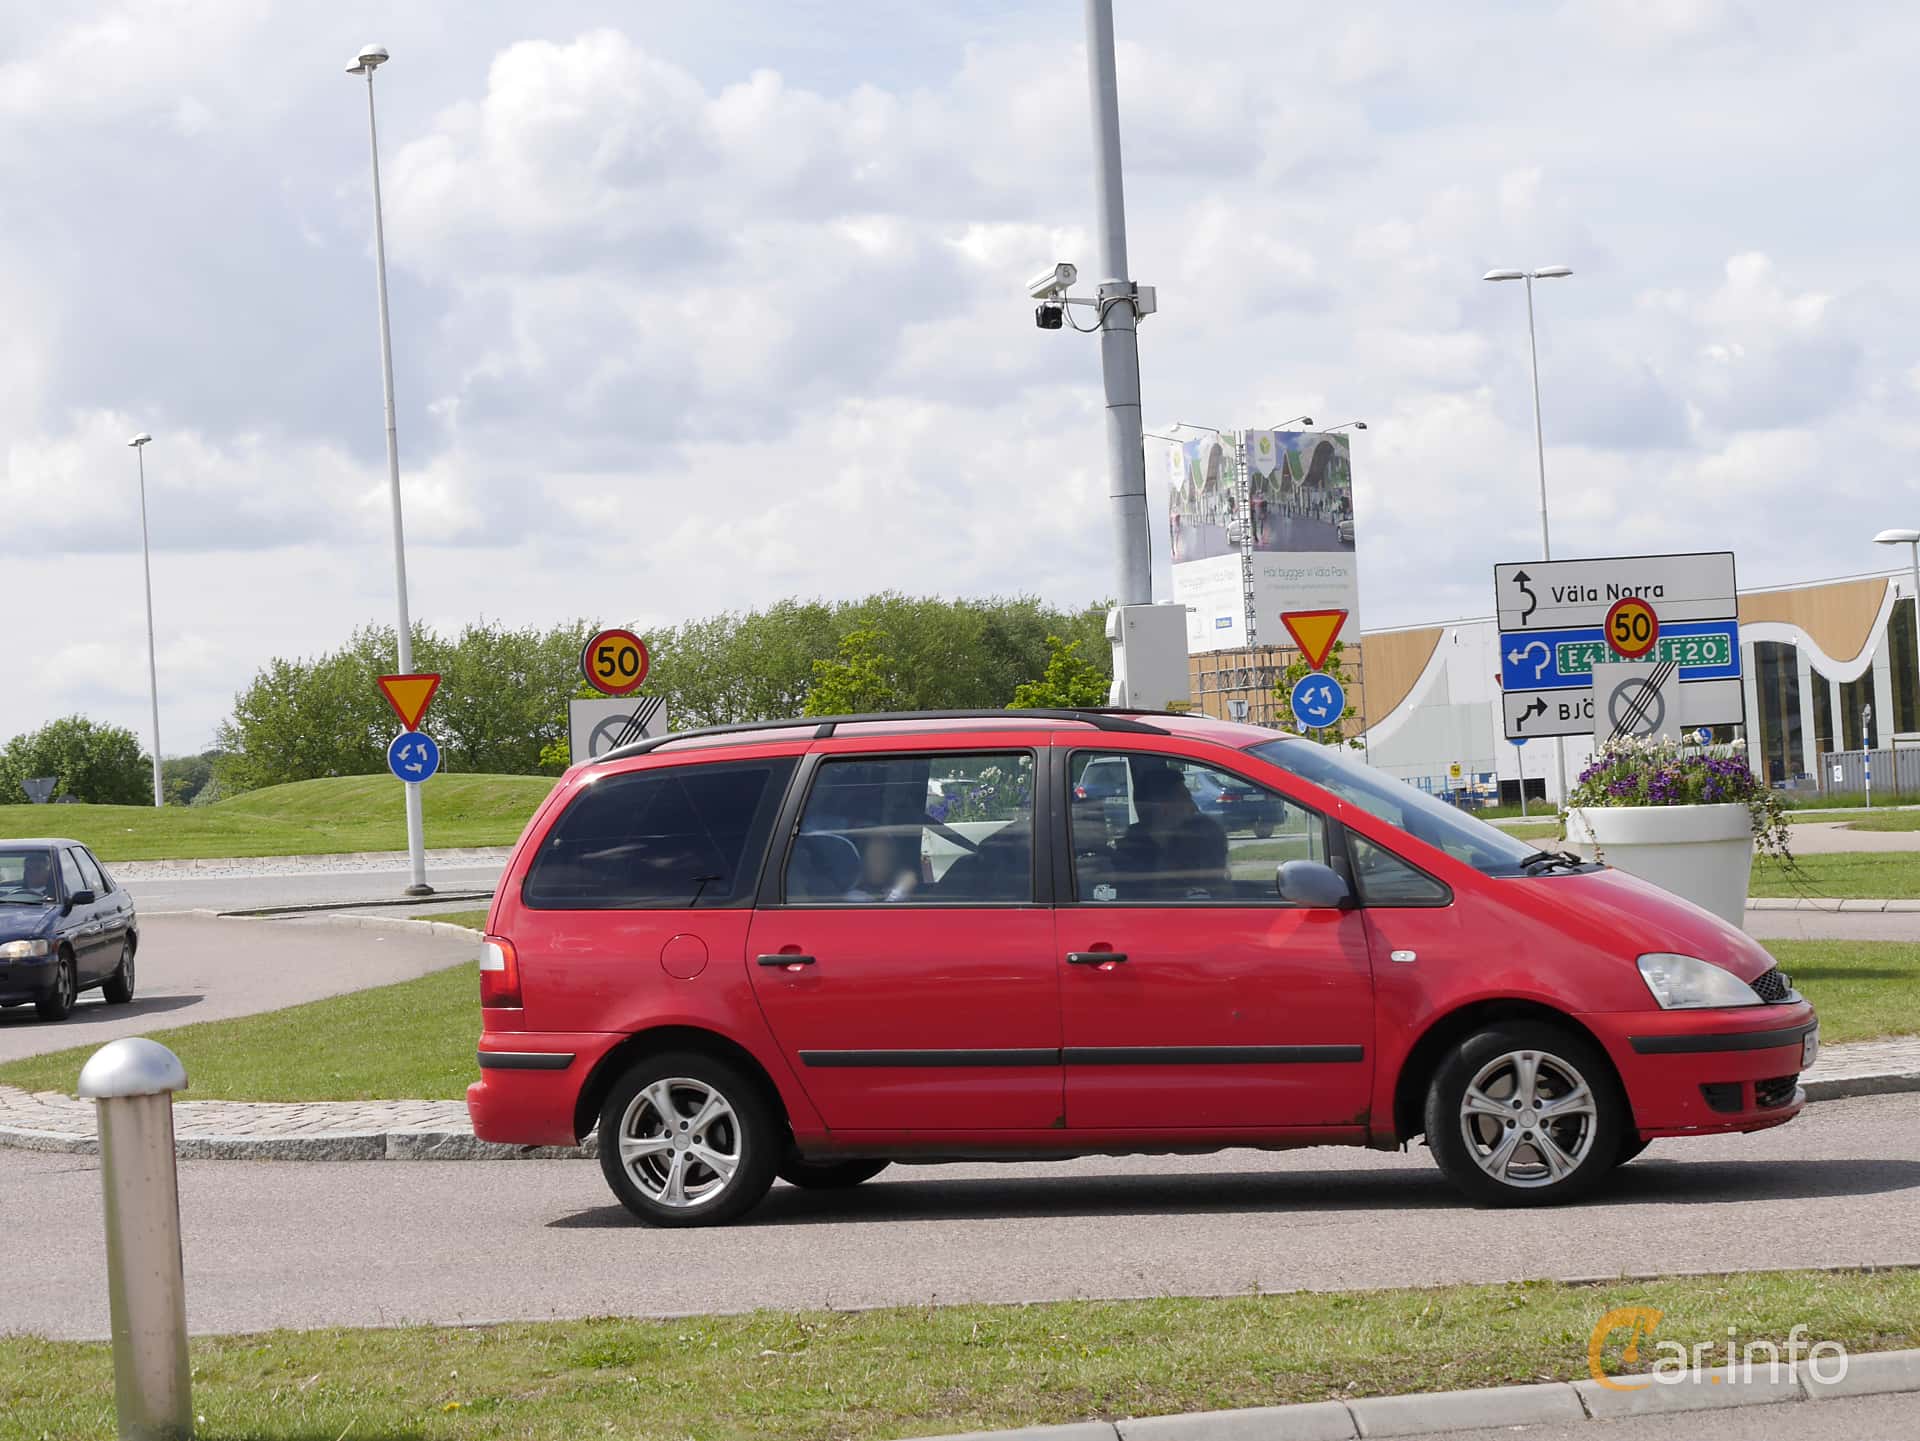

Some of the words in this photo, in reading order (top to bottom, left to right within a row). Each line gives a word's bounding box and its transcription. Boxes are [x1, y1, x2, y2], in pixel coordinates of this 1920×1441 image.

[1551, 585, 1598, 603] Väla
[1606, 583, 1664, 601] Norra
[1615, 613, 1651, 642] 50
[598, 646, 640, 677] 50
[1568, 648, 1596, 667] E4
[1671, 641, 1717, 661] E20
